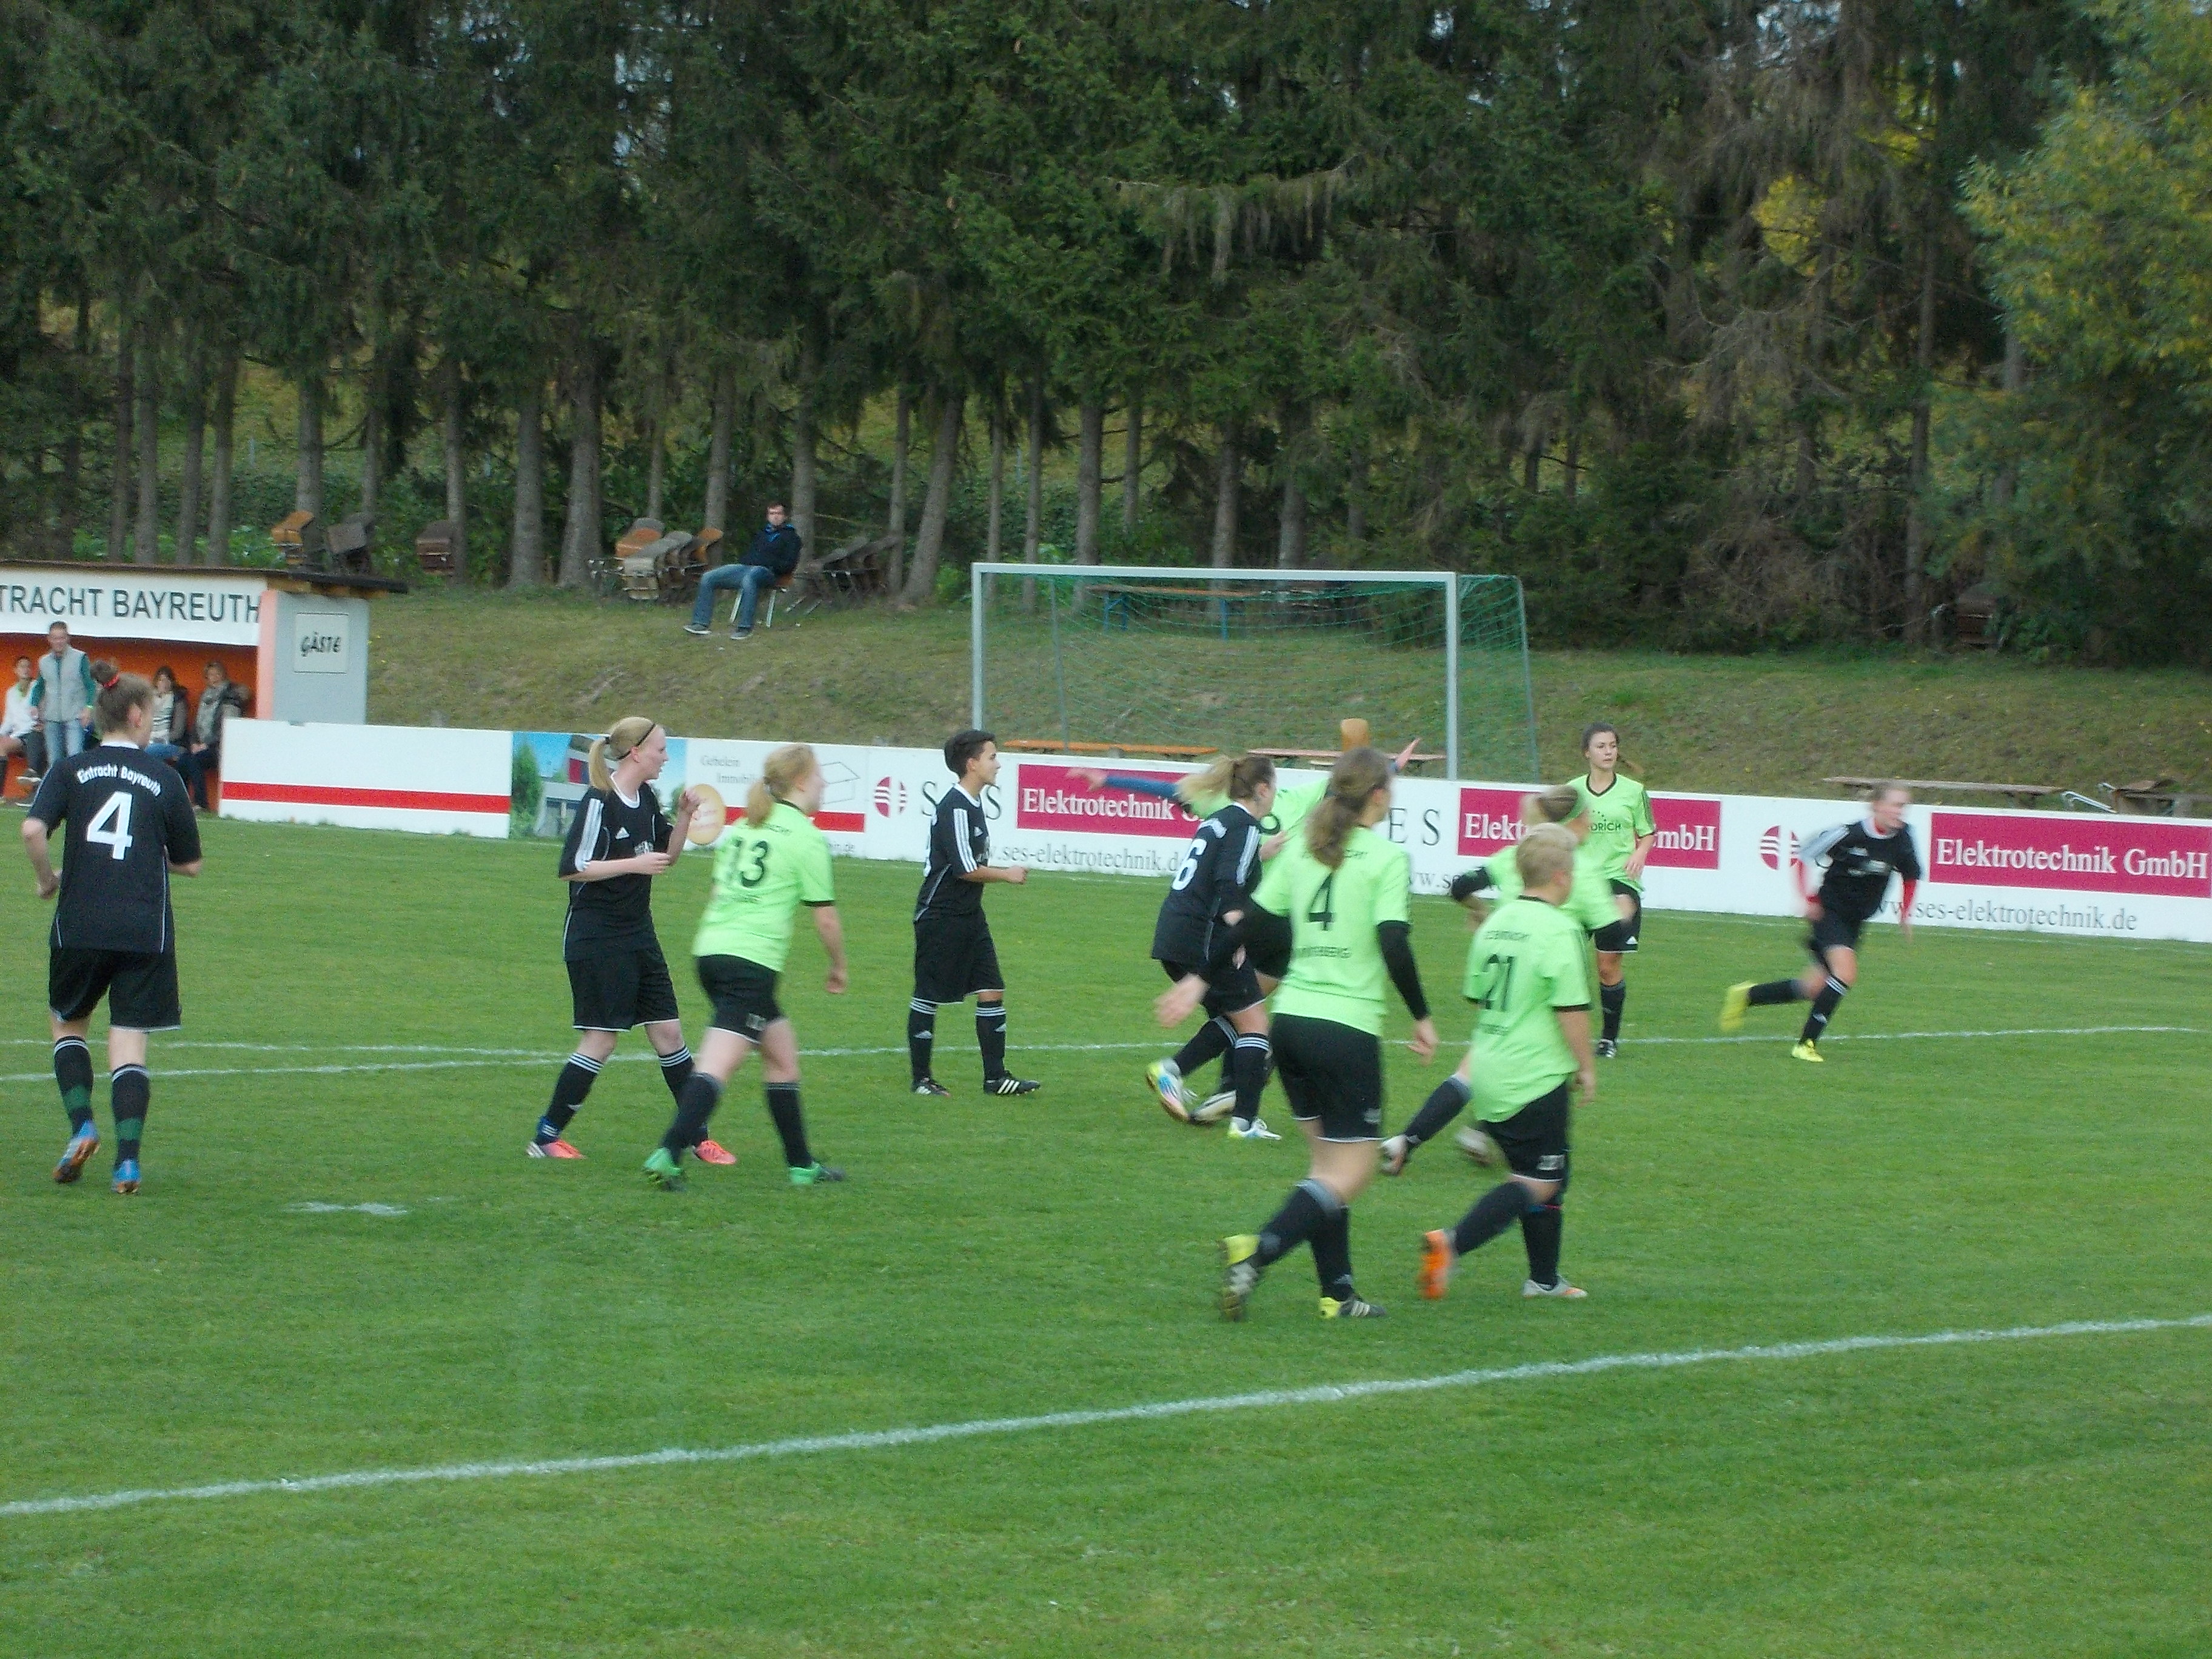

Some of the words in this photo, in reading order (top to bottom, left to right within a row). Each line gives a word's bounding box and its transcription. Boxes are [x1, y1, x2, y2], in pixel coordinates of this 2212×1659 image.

[113, 589, 261, 623] BAYREUTH
[77, 763, 118, 784] Eintracht
[121, 766, 161, 797] Bayreuth
[1022, 788, 1175, 820] Elektrotechnik
[86, 791, 133, 860] 4
[1653, 825, 1716, 851] mbH
[1171, 839, 1207, 891] 6
[1936, 838, 2117, 874] Elektrotechnik
[2123, 848, 2208, 879] GmbH
[1308, 871, 1335, 931] 4
